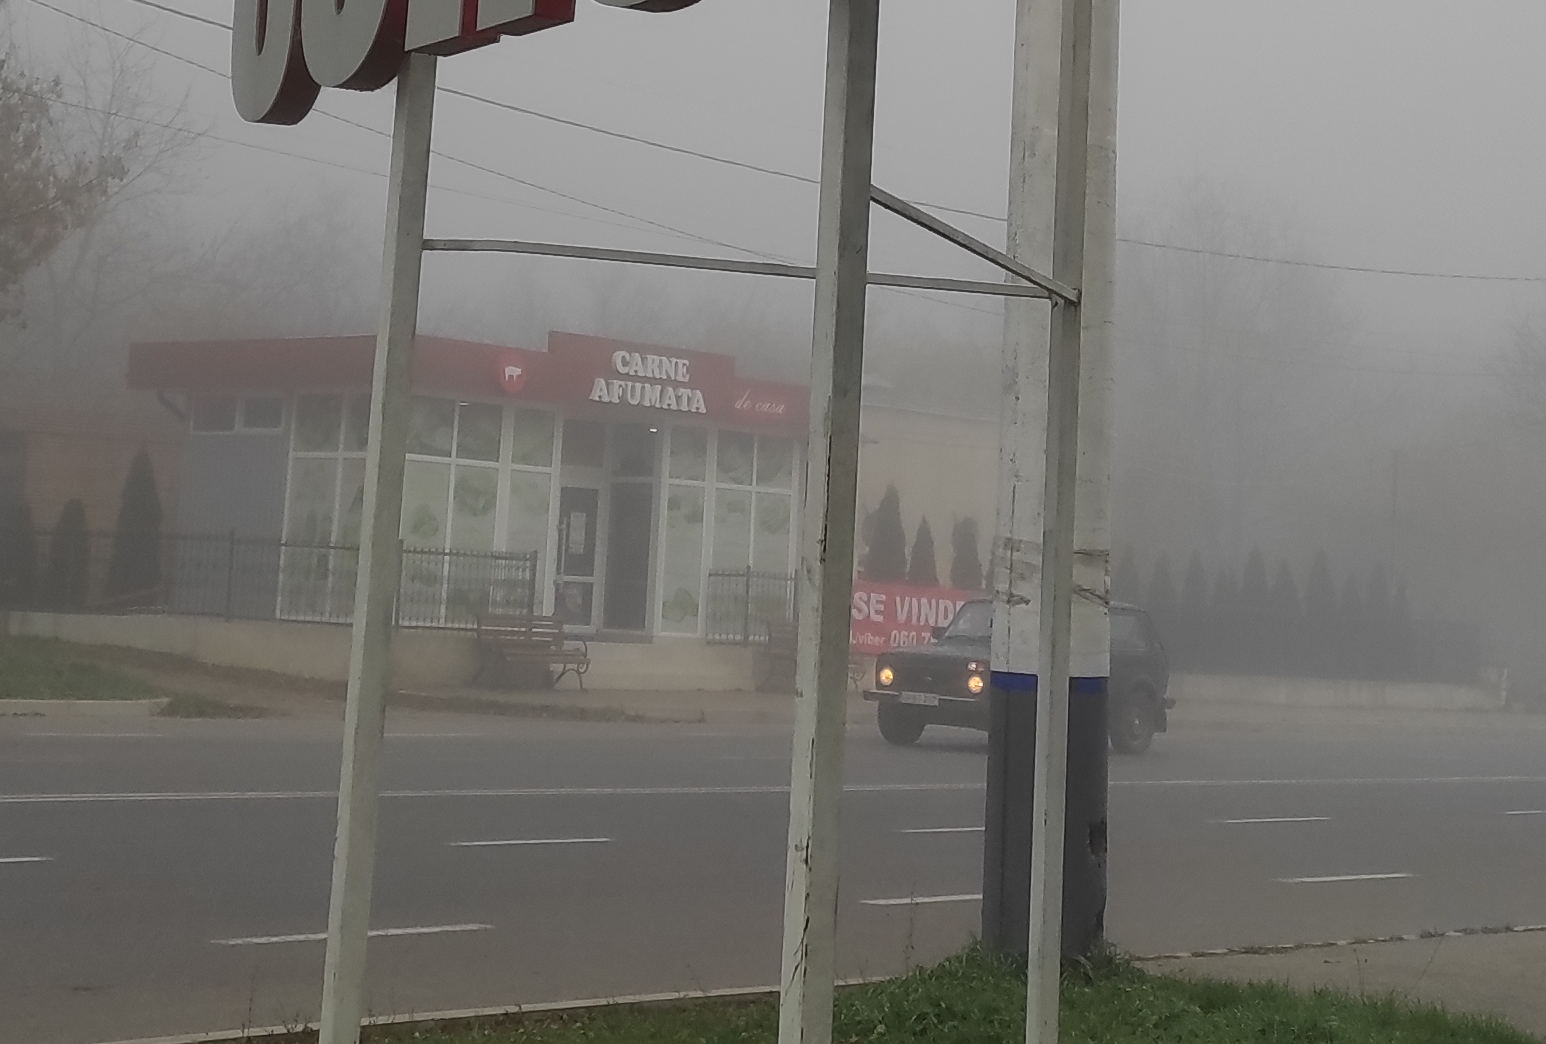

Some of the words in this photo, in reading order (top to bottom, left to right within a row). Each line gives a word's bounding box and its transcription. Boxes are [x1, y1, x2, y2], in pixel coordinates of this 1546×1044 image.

[611, 350, 690, 383] CARNE
[589, 377, 707, 414] AFUMATA
[734, 388, 752, 410] de
[754, 401, 786, 415] casa
[851, 591, 886, 623] SE
[890, 630, 917, 647] 060
